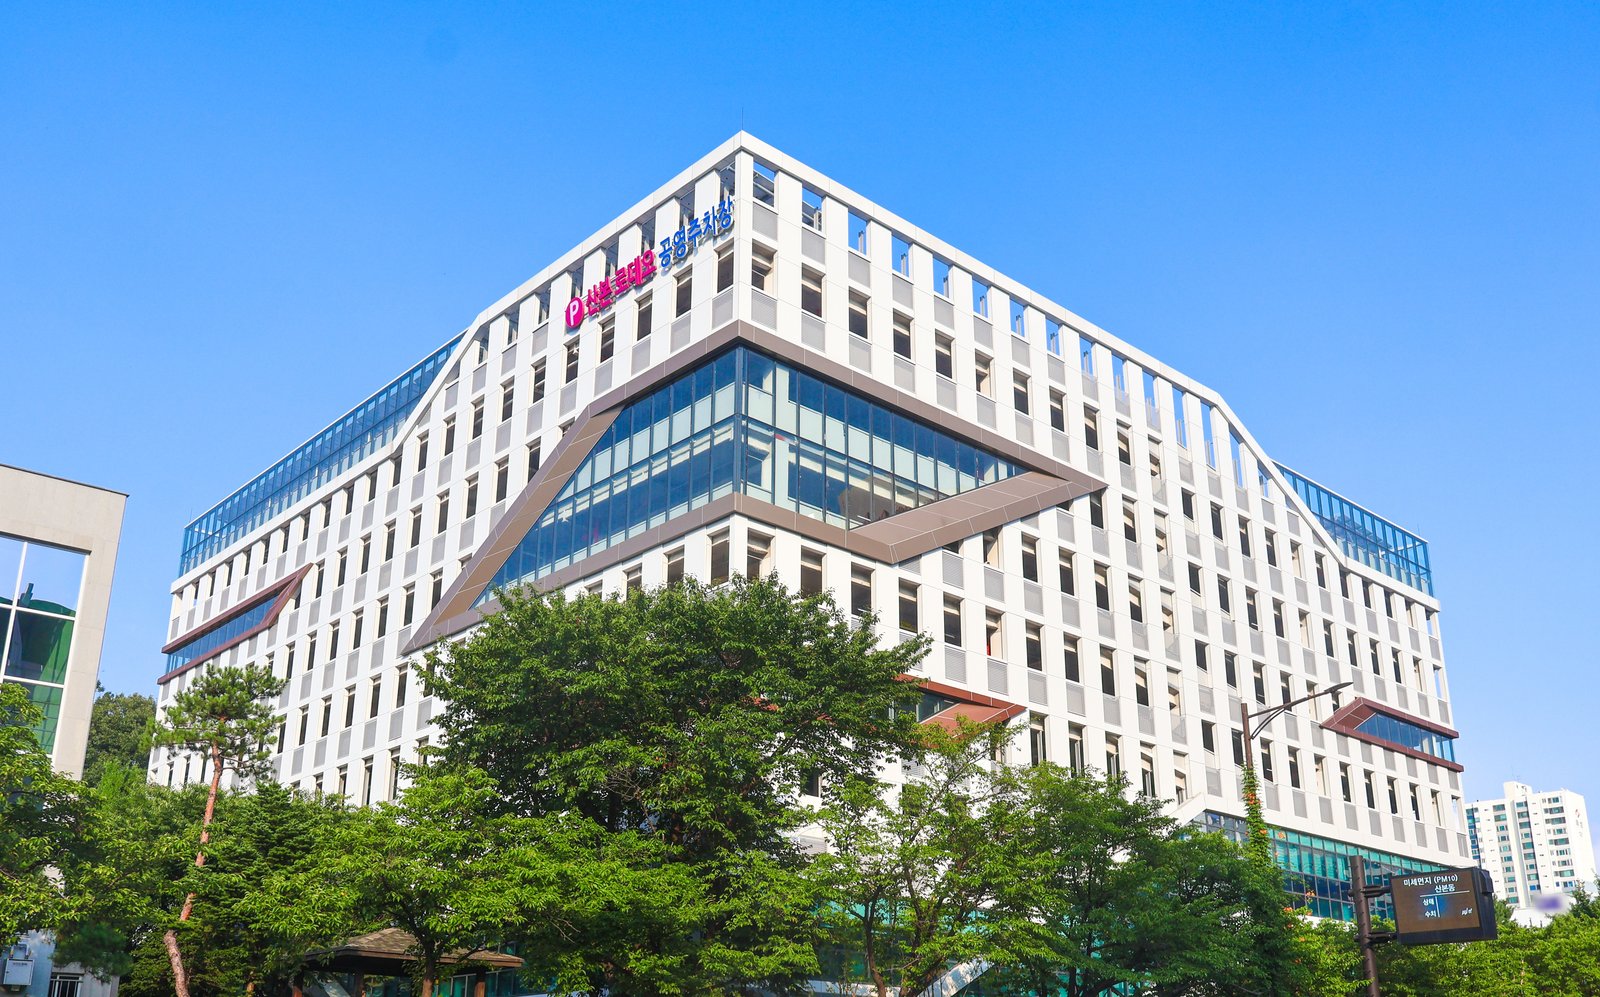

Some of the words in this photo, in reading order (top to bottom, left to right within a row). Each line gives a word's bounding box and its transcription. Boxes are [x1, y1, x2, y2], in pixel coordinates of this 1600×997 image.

[586, 276, 612, 316] 산본
[614, 250, 657, 296] 로데오
[659, 195, 734, 268] 공영주차장
[1403, 877, 1432, 887] 미세먼지
[1434, 874, 1458, 884] (PM10)
[1434, 884, 1456, 893] 산본동
